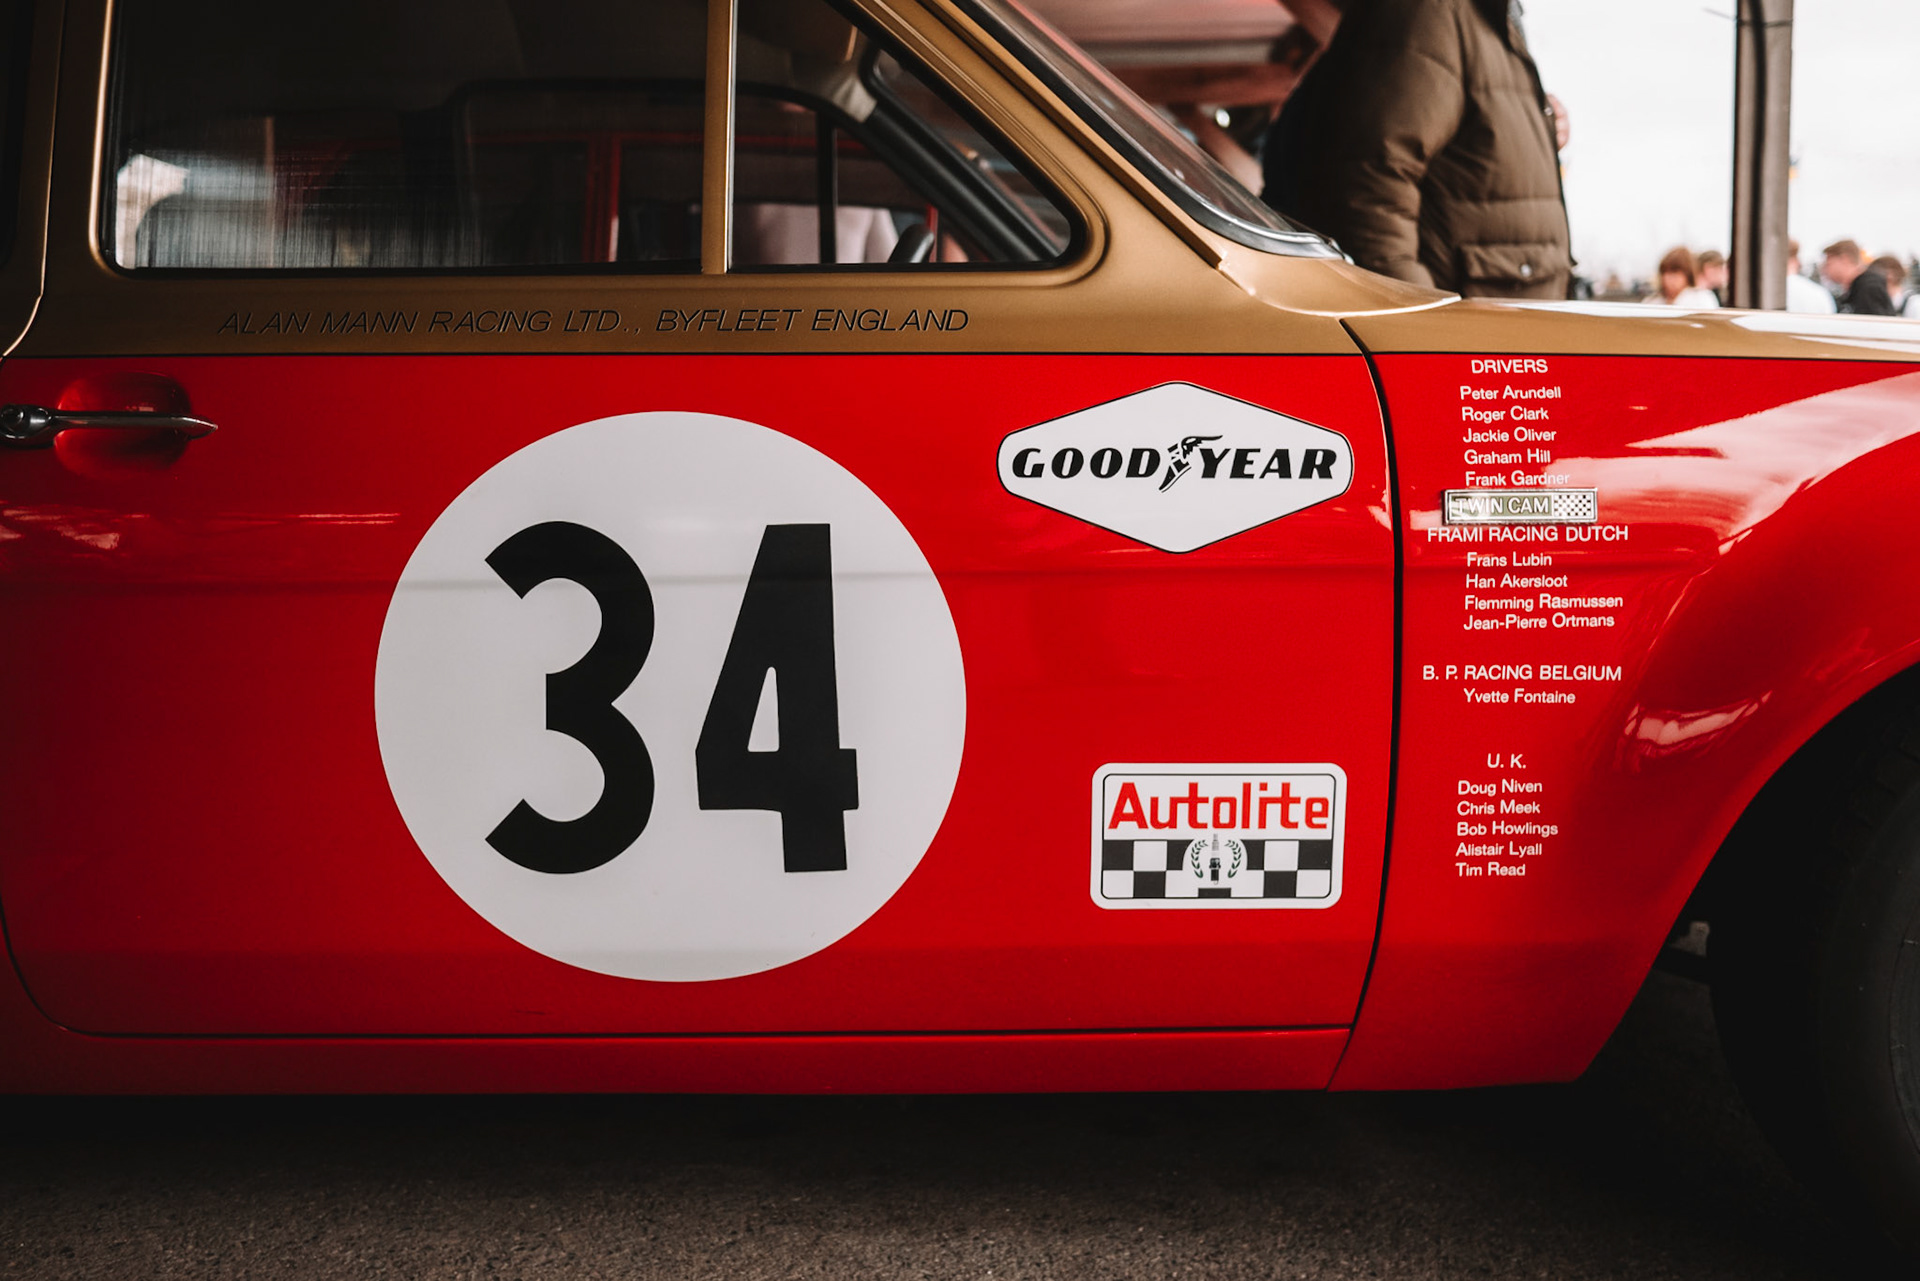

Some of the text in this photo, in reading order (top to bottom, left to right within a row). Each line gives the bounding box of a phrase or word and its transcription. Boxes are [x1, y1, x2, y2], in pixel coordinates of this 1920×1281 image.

[217, 311, 311, 334] ALAN
[319, 310, 419, 333] MANN
[428, 310, 551, 333] RACING
[655, 309, 802, 331] BYFLEET
[811, 309, 969, 331] ENGLAND
[1471, 359, 1548, 374] DRIVERS
[1460, 385, 1561, 400] Peter Arundell
[1461, 405, 1549, 423] Roger Clark
[1462, 426, 1556, 442] Jackie Oliver
[1463, 448, 1551, 465] Graham Hill
[1465, 470, 1570, 486] Frank Gardner
[1454, 497, 1549, 514] TWIN CAM
[1427, 525, 1629, 542] FRAMI RACING DUTCH
[1466, 551, 1552, 567] Frans Lubin
[1465, 572, 1568, 588] Han Akersloot
[1464, 593, 1623, 611] Flemming Rasmussen
[1463, 612, 1615, 630] Jean-Pierre Ortmans
[1422, 665, 1622, 681] B. P. RACING BELGIUM
[484, 521, 859, 875] 34
[1463, 688, 1576, 703] Yvette Fontaine
[1487, 753, 1527, 769] U. K.
[1457, 779, 1543, 796] Doug Niven
[1108, 782, 1329, 829] Autolite
[1457, 799, 1540, 816] Chris Meek
[1457, 821, 1558, 837] Bob Howlings
[1456, 841, 1543, 858] Alistair Lyall
[1455, 862, 1526, 877] Tim Read
